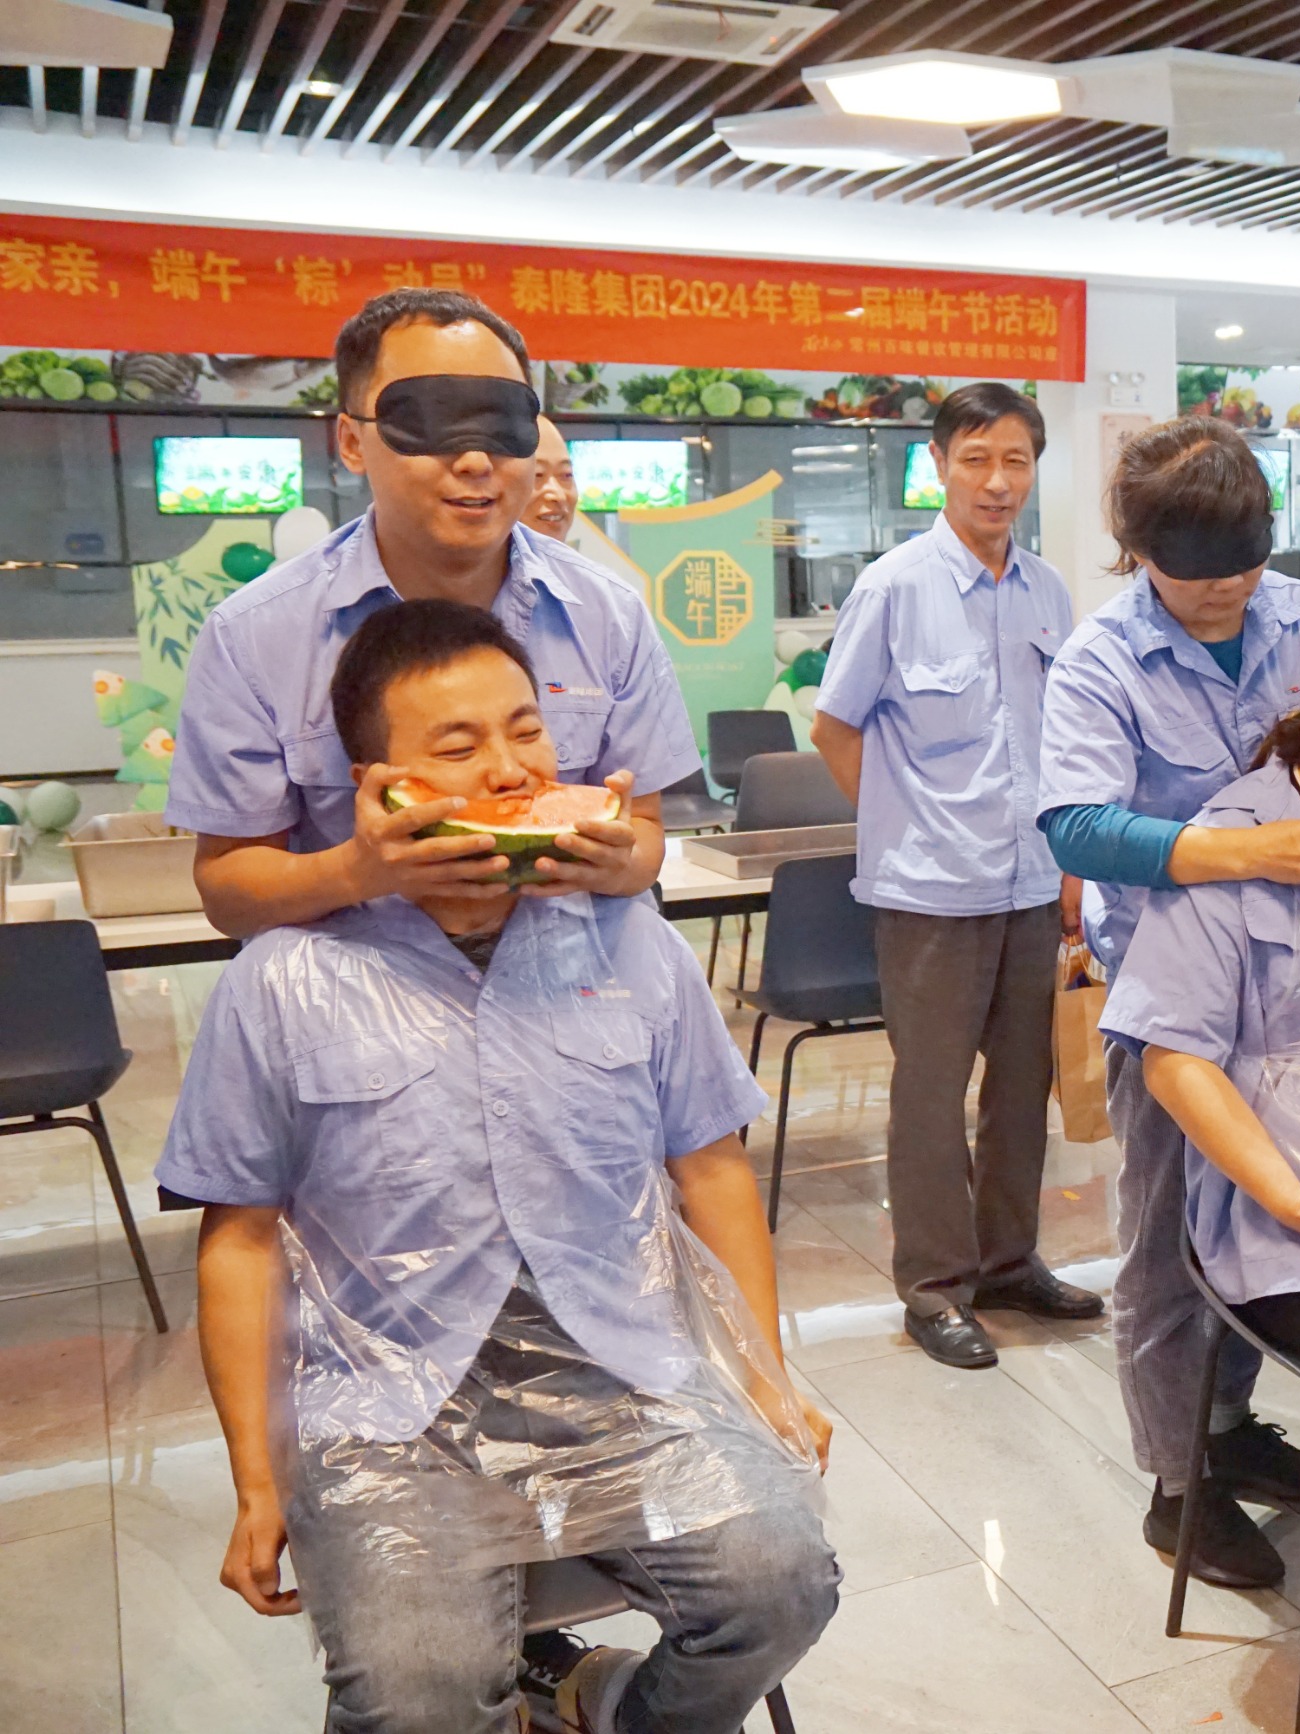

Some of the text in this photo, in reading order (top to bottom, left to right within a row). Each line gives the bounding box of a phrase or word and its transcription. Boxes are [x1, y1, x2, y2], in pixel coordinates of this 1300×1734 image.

[510, 266, 1058, 336] 泰隆集团2024年第二届端午节活动
[685, 559, 713, 635] 端午
